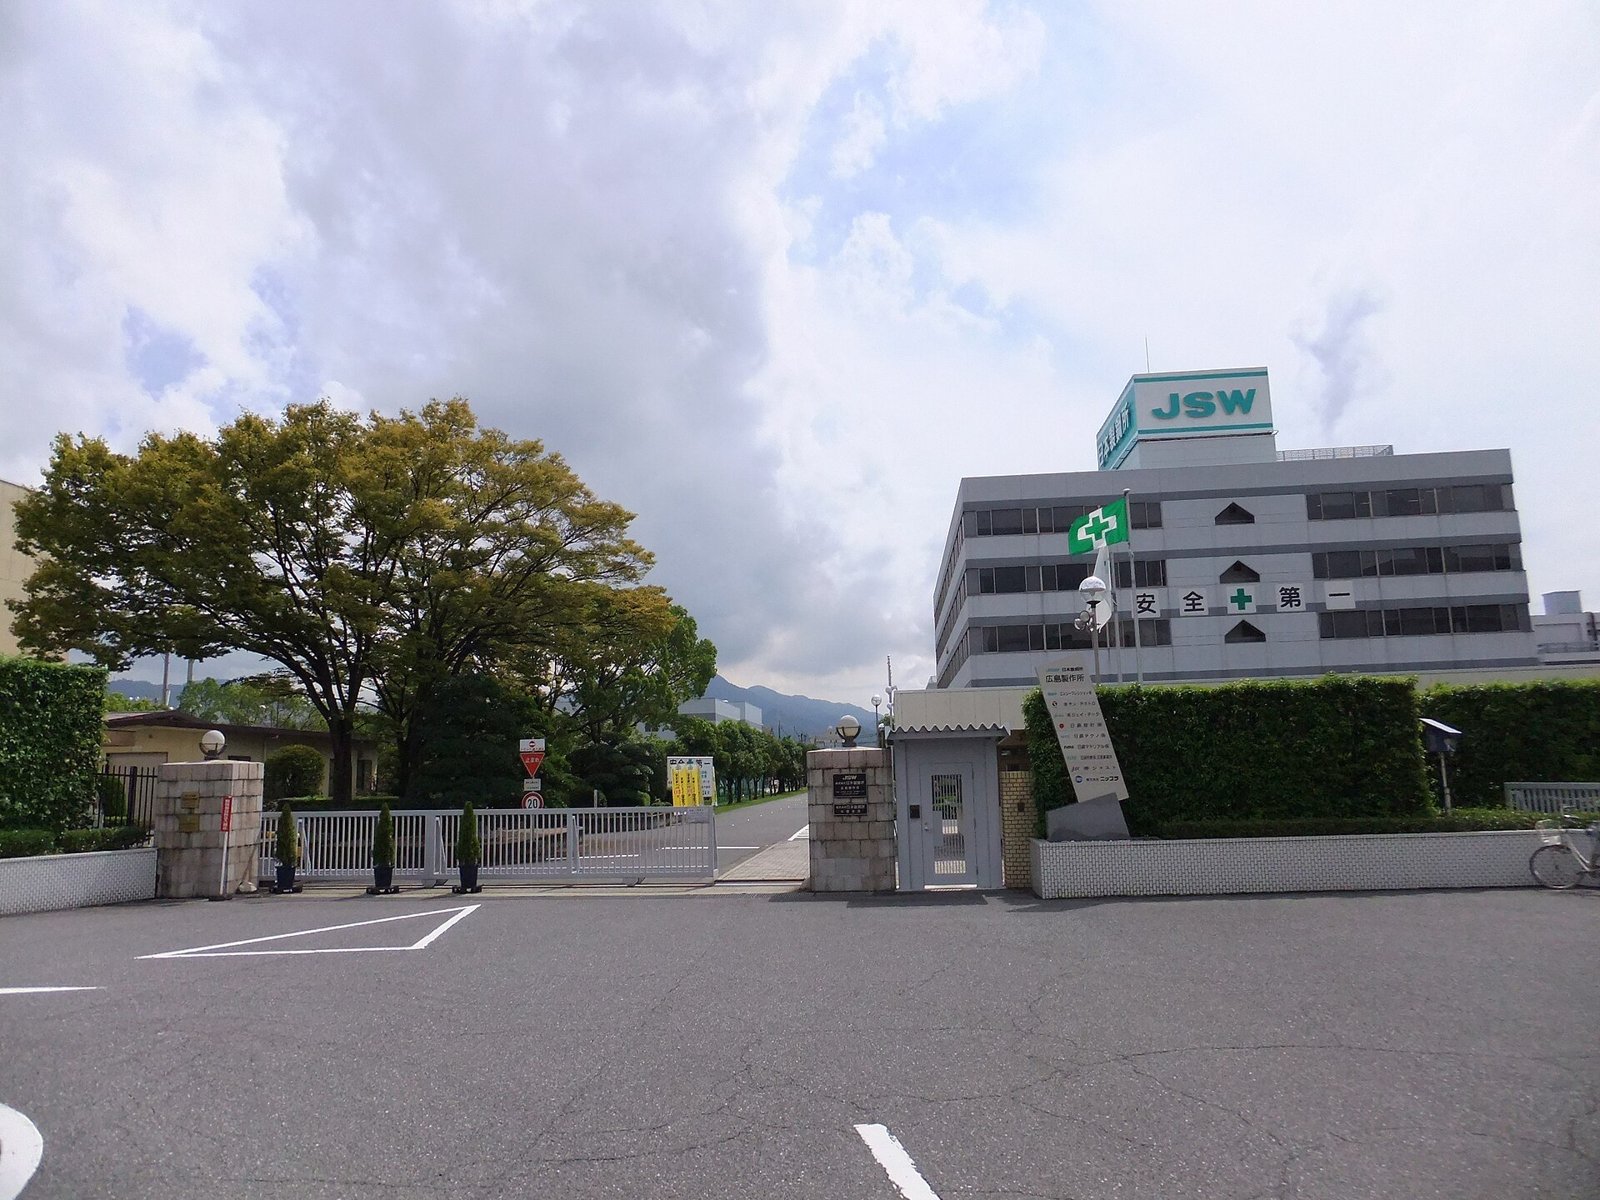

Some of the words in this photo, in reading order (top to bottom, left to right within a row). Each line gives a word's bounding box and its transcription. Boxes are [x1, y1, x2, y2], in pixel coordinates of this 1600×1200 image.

[1152, 389, 1256, 419] JSW
[1098, 402, 1130, 467] 日本製鋼所
[1046, 674, 1084, 683] 広島製作所
[528, 799, 538, 809] 20
